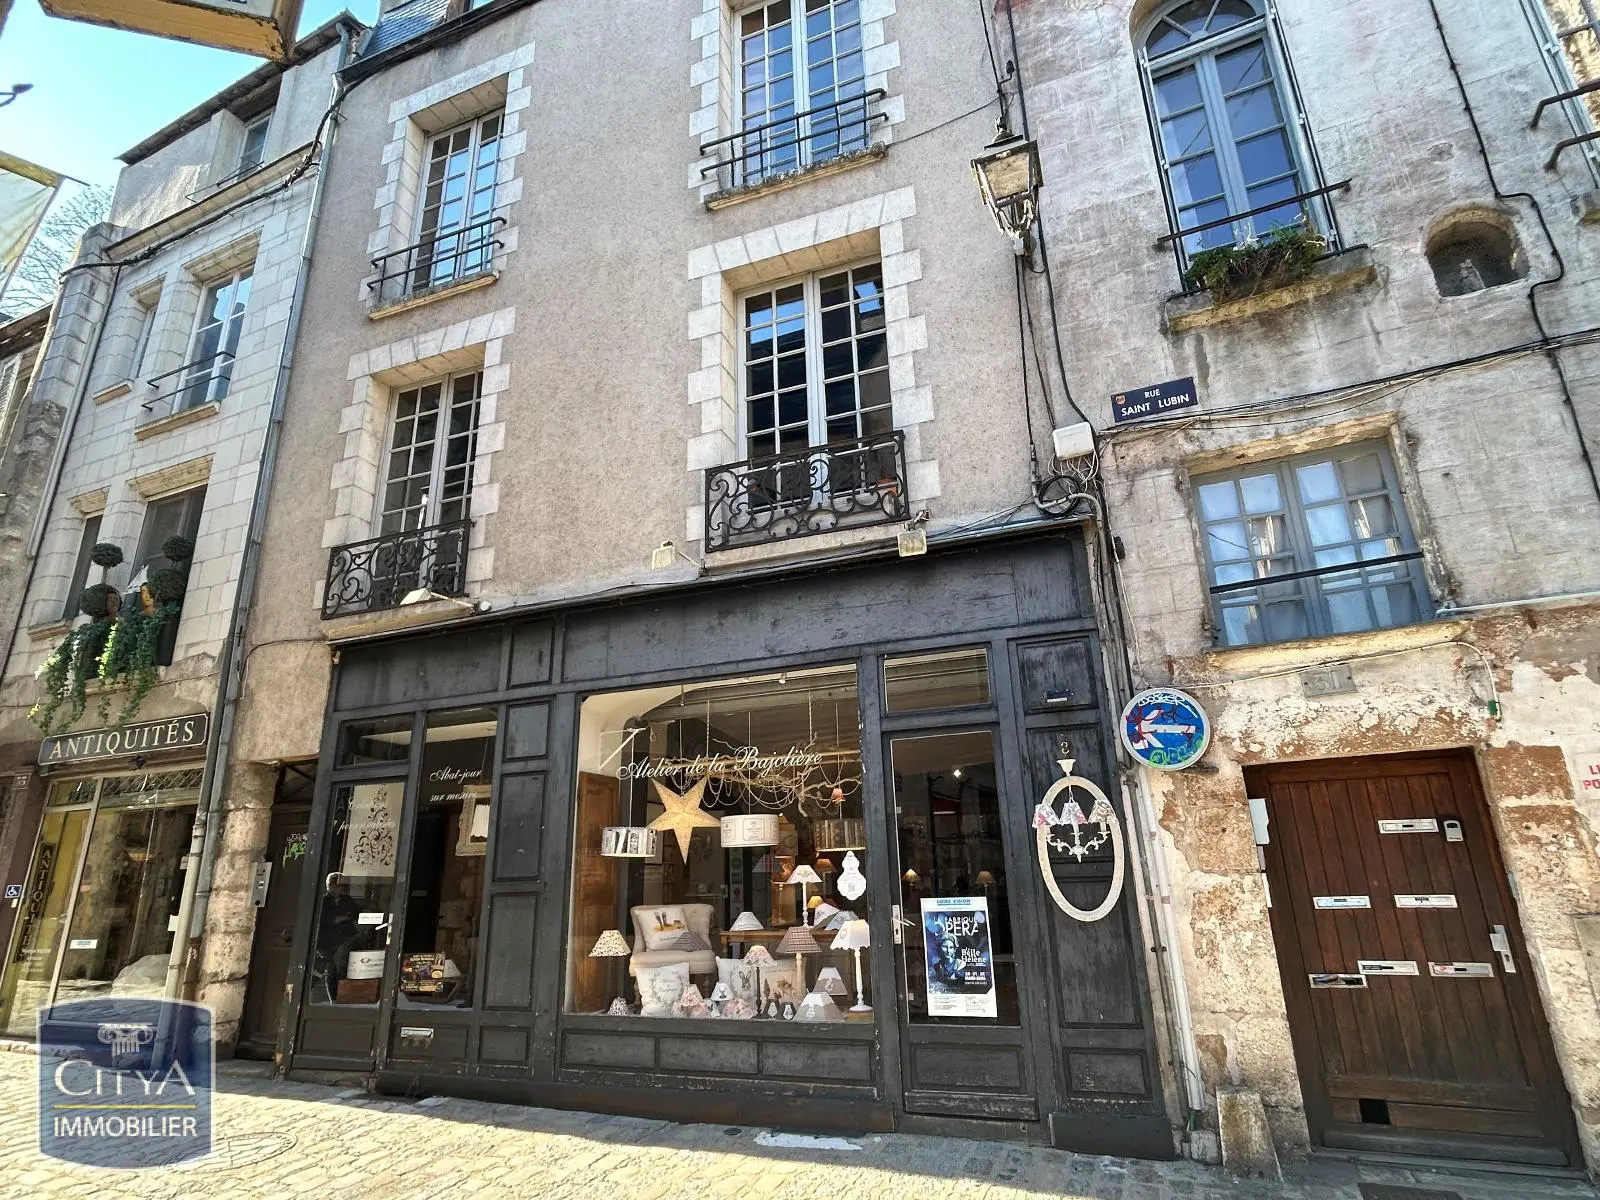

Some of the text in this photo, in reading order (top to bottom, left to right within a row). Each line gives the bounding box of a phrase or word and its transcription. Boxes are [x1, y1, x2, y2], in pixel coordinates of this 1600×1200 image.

[1144, 388, 1161, 399] RUE
[1121, 393, 1190, 416] SAINT LUBIN
[49, 720, 195, 759] ANTIQUITÉS
[616, 746, 823, 781] Atelier de la Bajolière
[429, 765, 482, 785] Abat-jour
[430, 791, 478, 802] sur mesure
